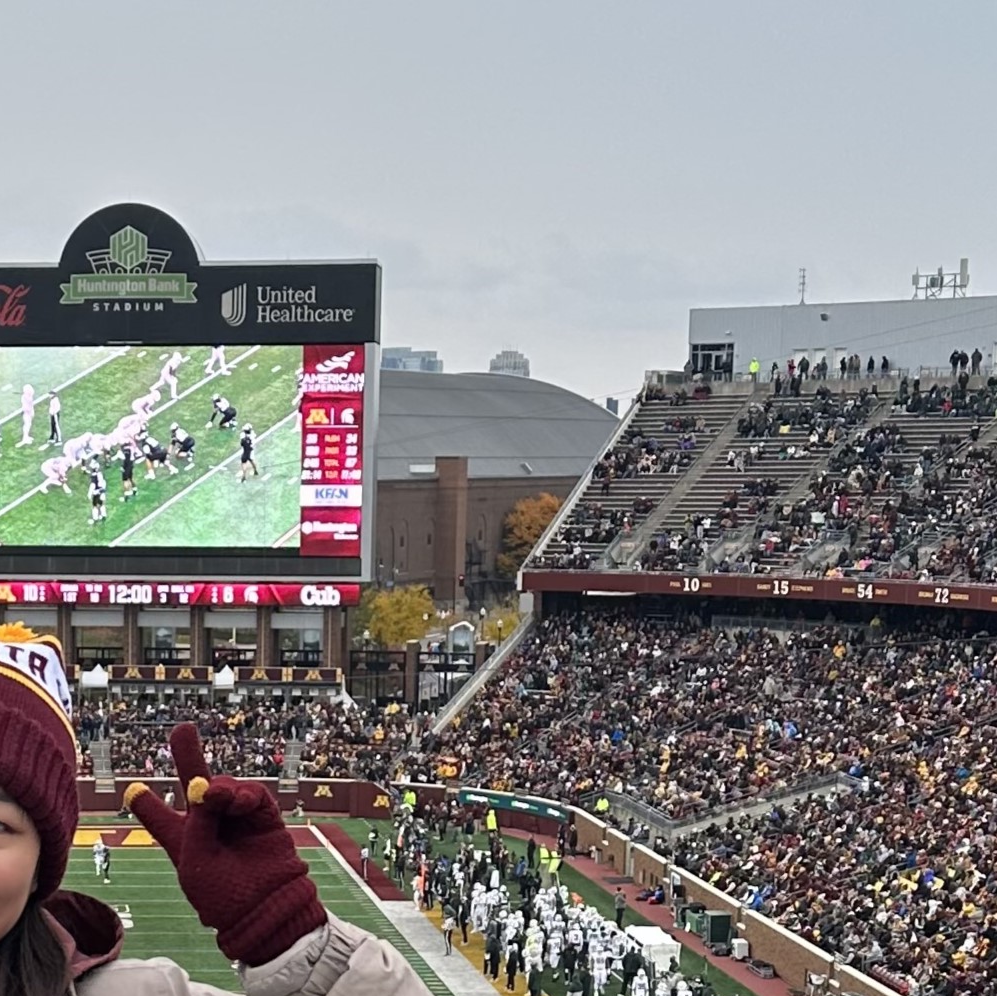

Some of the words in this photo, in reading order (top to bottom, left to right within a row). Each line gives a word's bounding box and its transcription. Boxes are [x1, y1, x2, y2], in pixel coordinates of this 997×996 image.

[78, 278, 146, 295] Huntington
[148, 278, 180, 292] Bank
[256, 285, 317, 304] United
[93, 303, 164, 311] STADIUM
[256, 305, 353, 323] Healthcare
[303, 372, 365, 384] AMERICAN
[683, 577, 700, 592] 10
[773, 580, 790, 595] 15
[857, 583, 873, 599] 54
[108, 584, 152, 604] 12:00
[300, 585, 341, 605] Cub
[934, 588, 949, 604] 72
